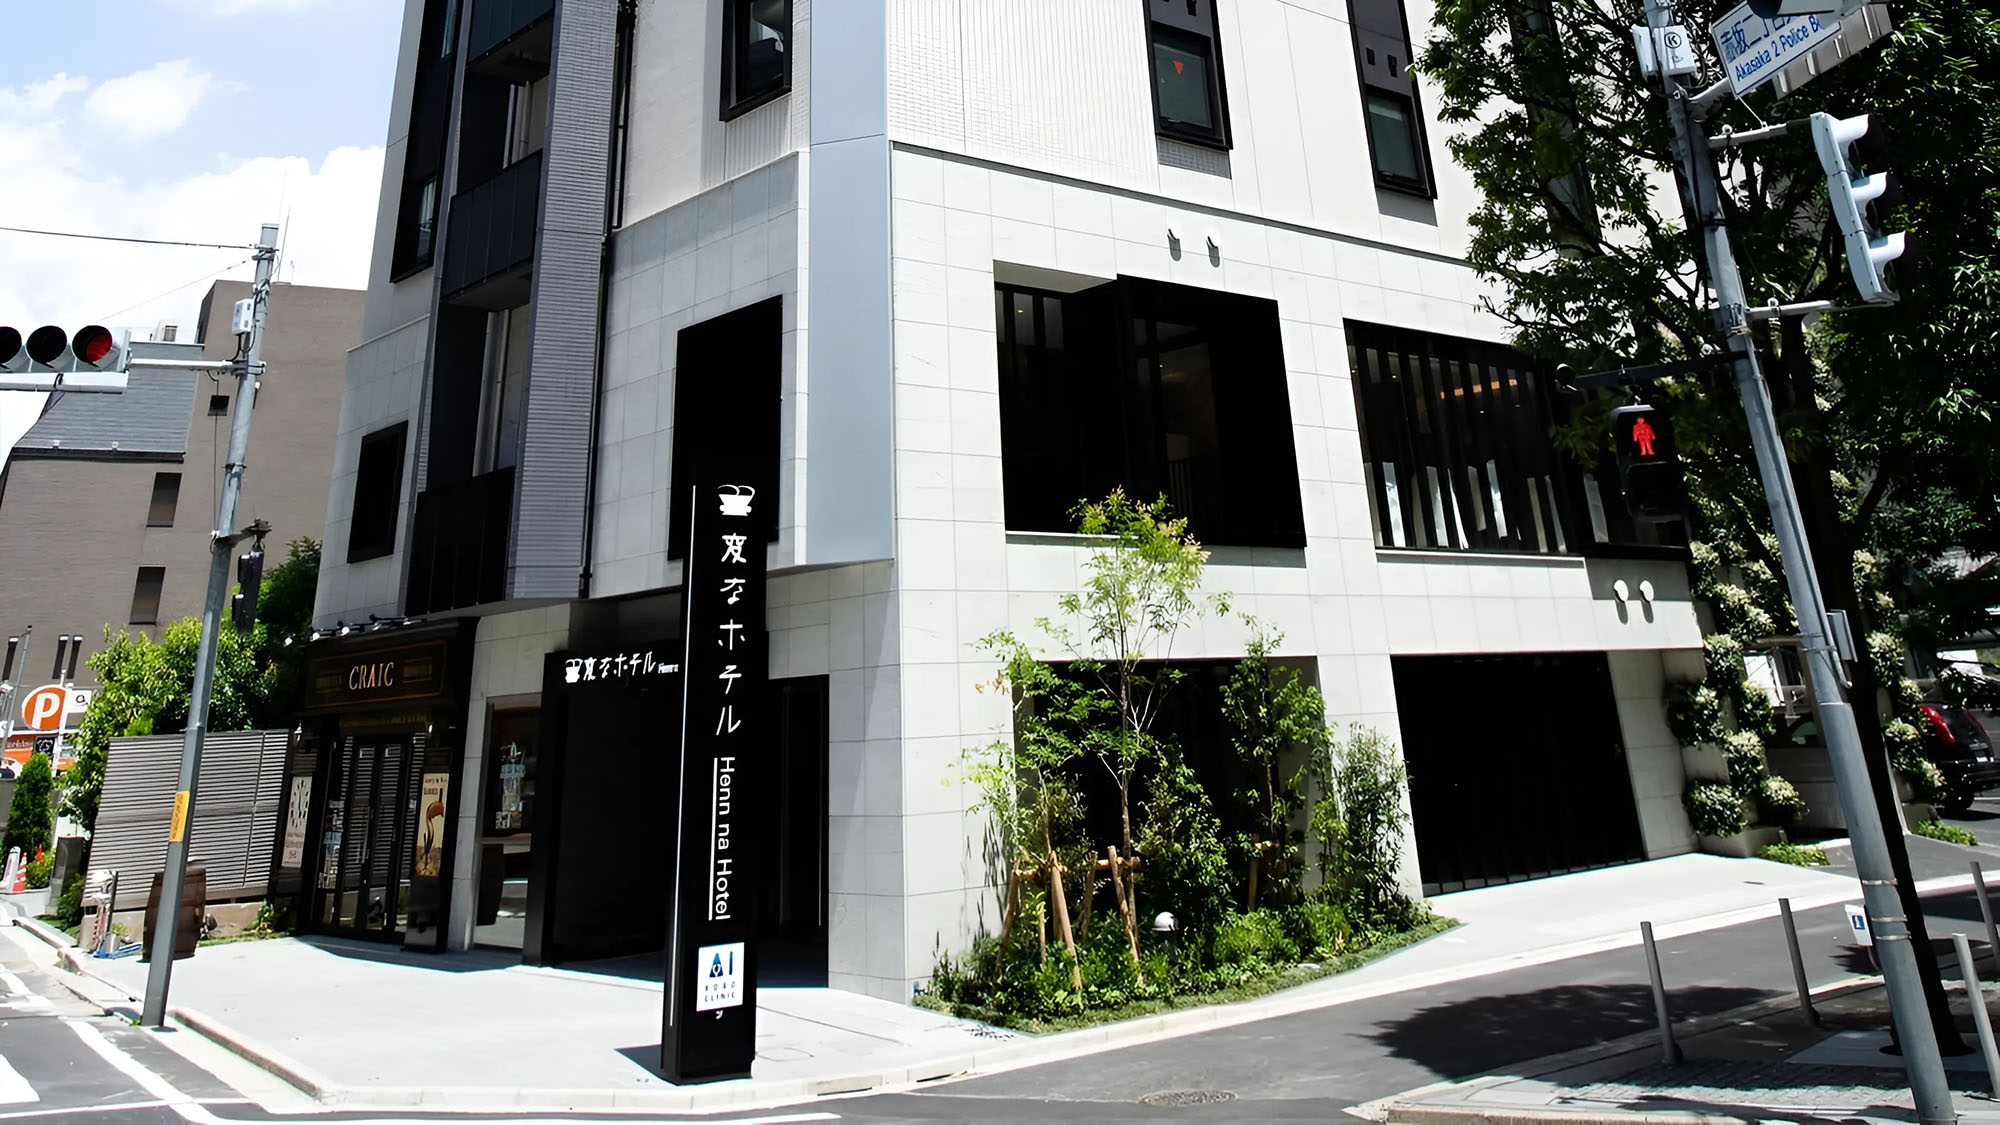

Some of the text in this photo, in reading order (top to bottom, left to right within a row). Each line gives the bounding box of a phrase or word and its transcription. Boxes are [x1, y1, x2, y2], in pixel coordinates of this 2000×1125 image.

[1735, 49, 1772, 82] Akasaka
[1770, 40, 1780, 58] 2
[1779, 25, 1810, 52] Police
[715, 532, 748, 736] 変なホテル
[348, 661, 395, 690] CRAIC
[31, 692, 60, 730] P
[714, 757, 736, 921] Henn na Hotel
[709, 951, 734, 978] AI
